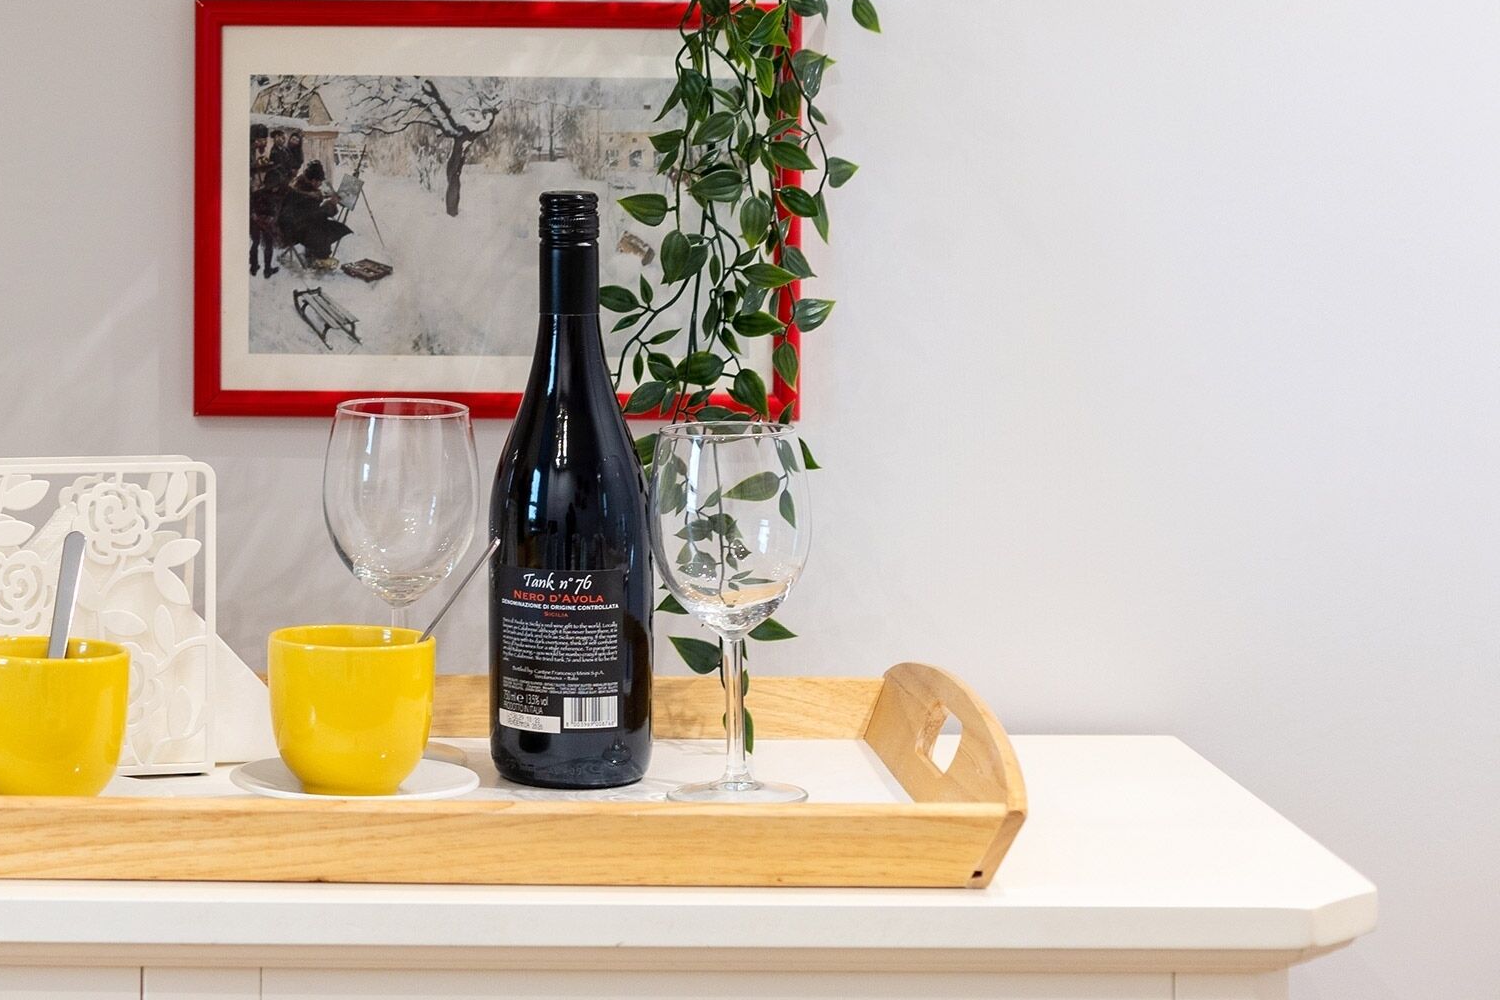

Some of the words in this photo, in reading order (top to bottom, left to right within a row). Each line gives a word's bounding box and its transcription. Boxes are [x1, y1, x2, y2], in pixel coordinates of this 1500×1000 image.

[523, 572, 555, 590] Tank
[575, 575, 592, 594] 76
[501, 598, 542, 609] DENOMINAZIONE
[577, 603, 619, 611] CONTROLLATA
